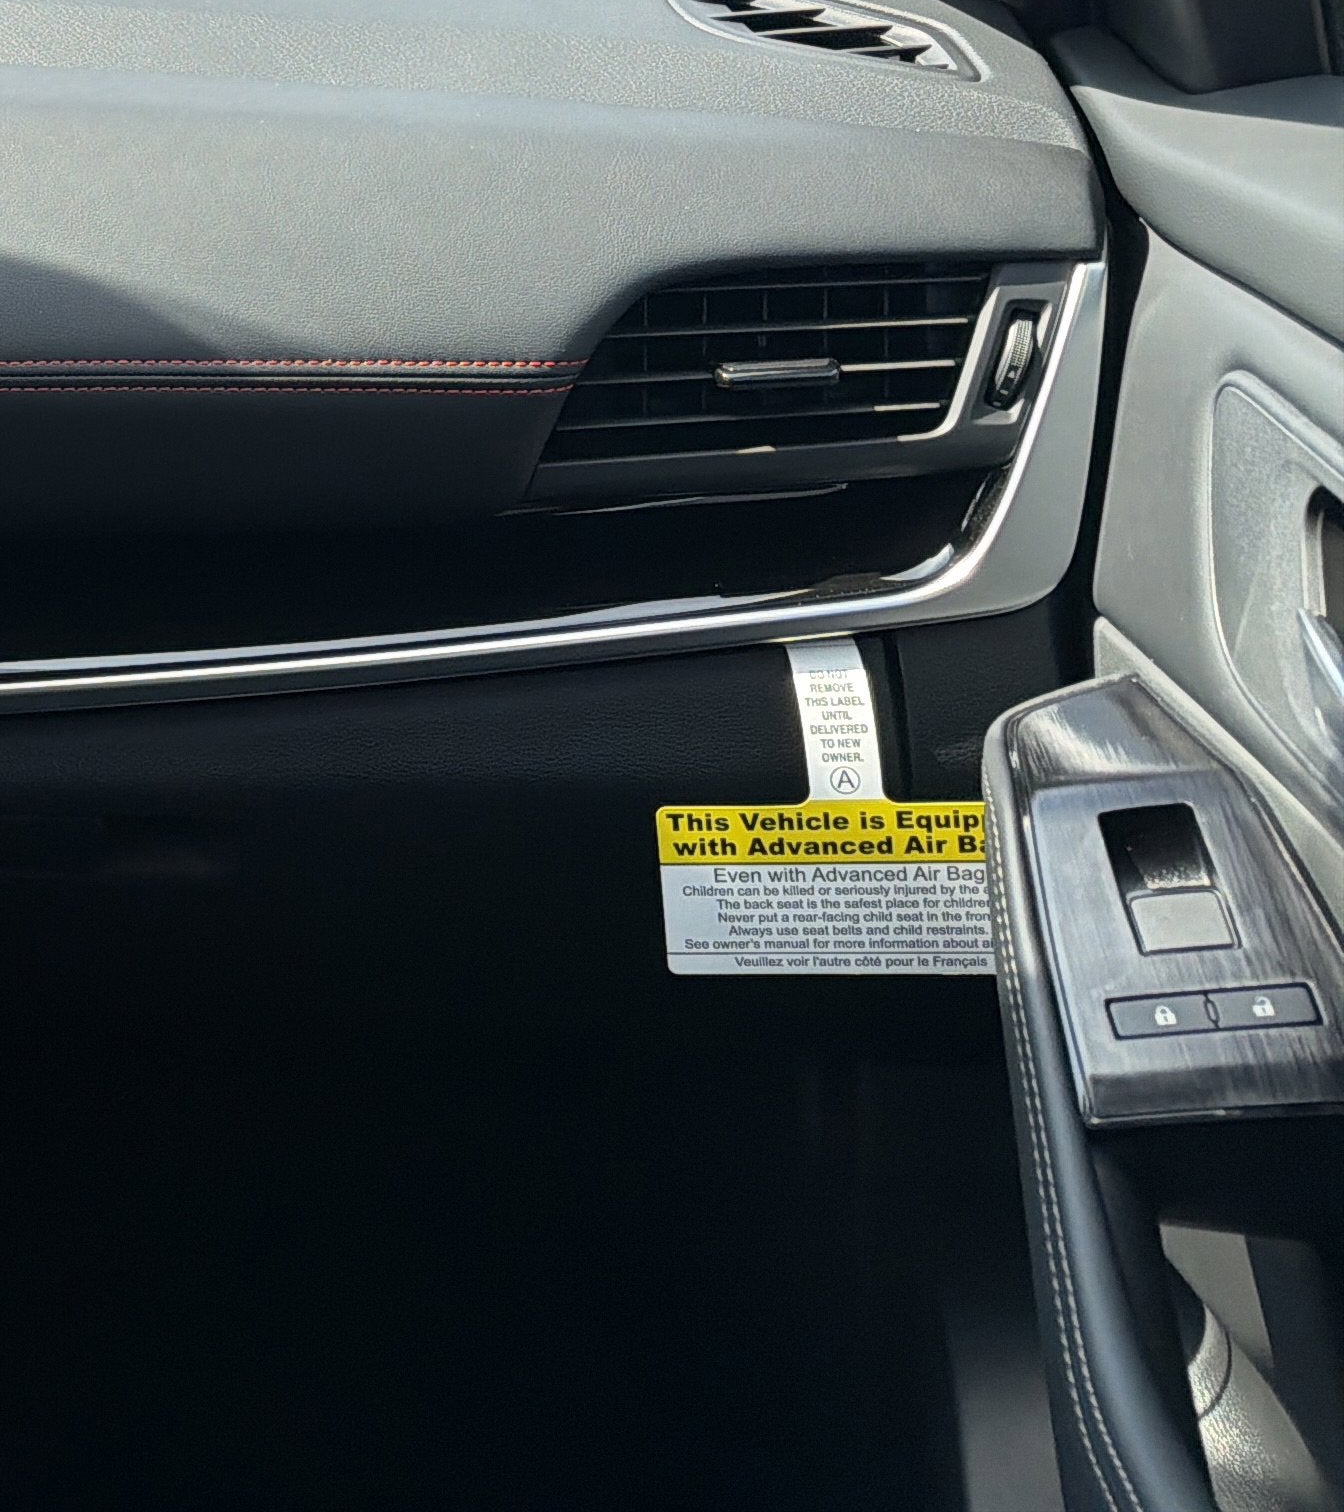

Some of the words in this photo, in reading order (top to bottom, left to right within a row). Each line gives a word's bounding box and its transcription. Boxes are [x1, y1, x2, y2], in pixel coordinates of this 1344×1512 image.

[810, 683, 854, 693] REMOVE
[805, 697, 828, 706] THIS
[831, 696, 865, 706] LABEL
[822, 711, 853, 720] UNTIL
[810, 724, 868, 734] DELIVERED
[820, 739, 835, 748] TO
[838, 739, 861, 748] NEW
[822, 752, 864, 763] OWNER.
[666, 813, 730, 831] This
[738, 812, 849, 831] Vehicle
[859, 811, 885, 830] is
[896, 810, 986, 833] Equip
[672, 838, 737, 856] with
[748, 836, 892, 856] Advanced
[904, 835, 947, 854] Air
[714, 867, 761, 883] Even
[768, 867, 806, 883] with
[812, 866, 907, 882] Advanced
[913, 866, 940, 882] Air
[682, 885, 734, 897] Children
[737, 888, 760, 896] can
[764, 886, 780, 896] be
[782, 886, 815, 896] killed
[818, 887, 832, 896] or
[834, 886, 890, 897] seriously
[894, 885, 937, 897] injured
[940, 885, 956, 897] by
[959, 885, 980, 895] the
[717, 899, 741, 910] The
[744, 899, 774, 909] back
[777, 900, 804, 909] seat
[807, 899, 817, 909] is
[820, 899, 840, 909] the
[844, 898, 882, 908] safest
[885, 898, 919, 910] place
[923, 898, 940, 908] for
[718, 912, 755, 923] Never
[758, 913, 778, 924] put
[781, 914, 789, 923] a
[793, 912, 860, 924] rear-facing
[863, 912, 893, 922] child
[896, 912, 923, 922] seat
[927, 912, 938, 922] in
[942, 911, 961, 921] the
[729, 925, 773, 938] Always
[776, 927, 798, 936] use
[802, 926, 829, 936] seat
[832, 925, 863, 936] belts
[866, 925, 890, 935] and
[893, 925, 923, 935] child
[926, 925, 989, 935] restraints.
[685, 939, 709, 949] See
[712, 939, 761, 949] owner's
[764, 938, 809, 949] manual
[813, 938, 829, 949] for
[833, 940, 865, 949] more
[869, 939, 939, 949] information
[943, 938, 979, 949] about
[734, 956, 783, 967] Veuillez
[787, 956, 810, 967] voir
[813, 956, 851, 967] l'autre
[854, 956, 882, 967] côté
[885, 957, 913, 969] pour
[917, 956, 929, 967] le
[933, 956, 988, 969] Français
